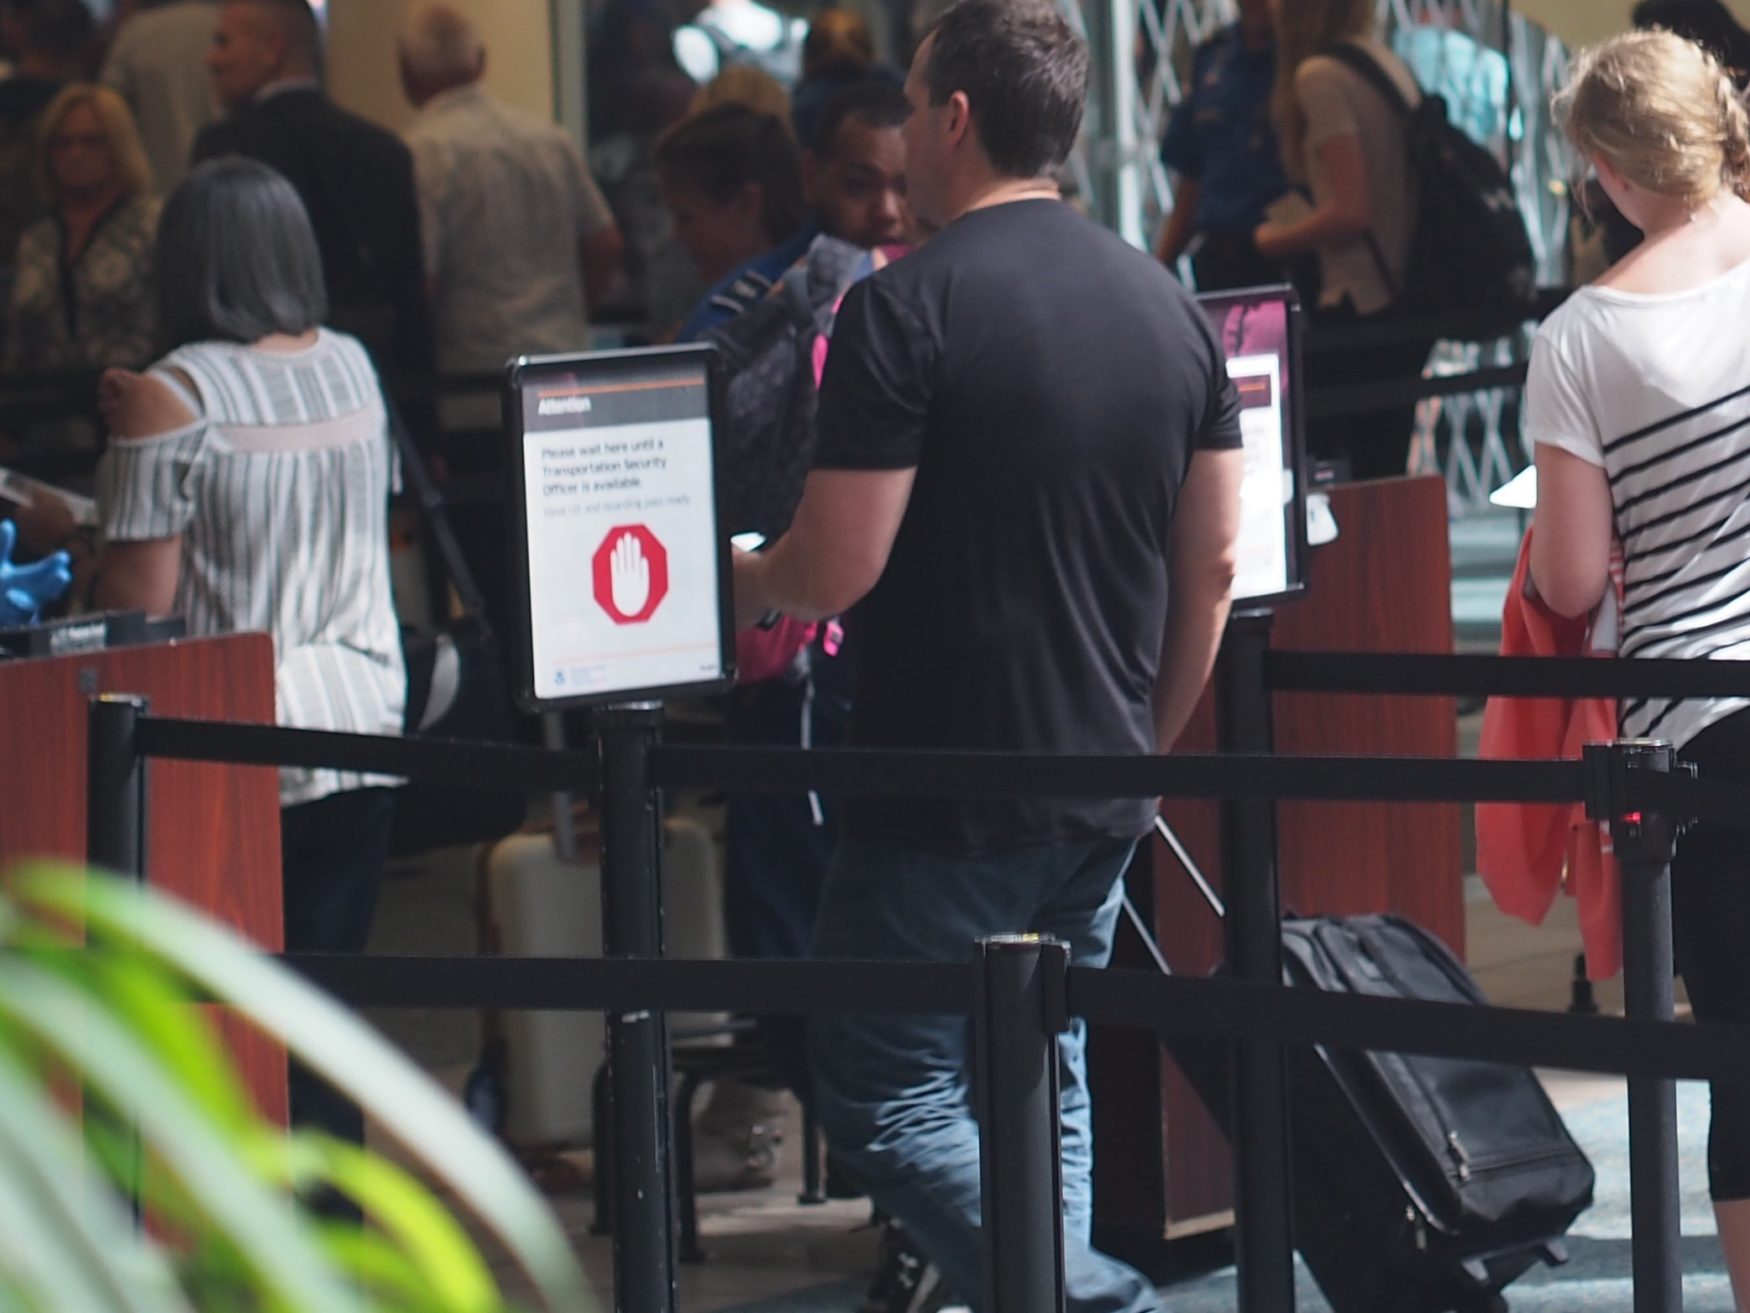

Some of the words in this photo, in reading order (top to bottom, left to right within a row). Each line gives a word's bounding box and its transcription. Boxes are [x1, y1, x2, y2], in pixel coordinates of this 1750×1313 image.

[541, 446, 576, 459] Please
[579, 443, 601, 456] wait
[603, 442, 629, 454] here
[631, 438, 655, 451] until
[543, 460, 621, 478] Transportation
[624, 456, 667, 472] Security
[543, 481, 578, 497] Officer
[581, 481, 590, 492] is
